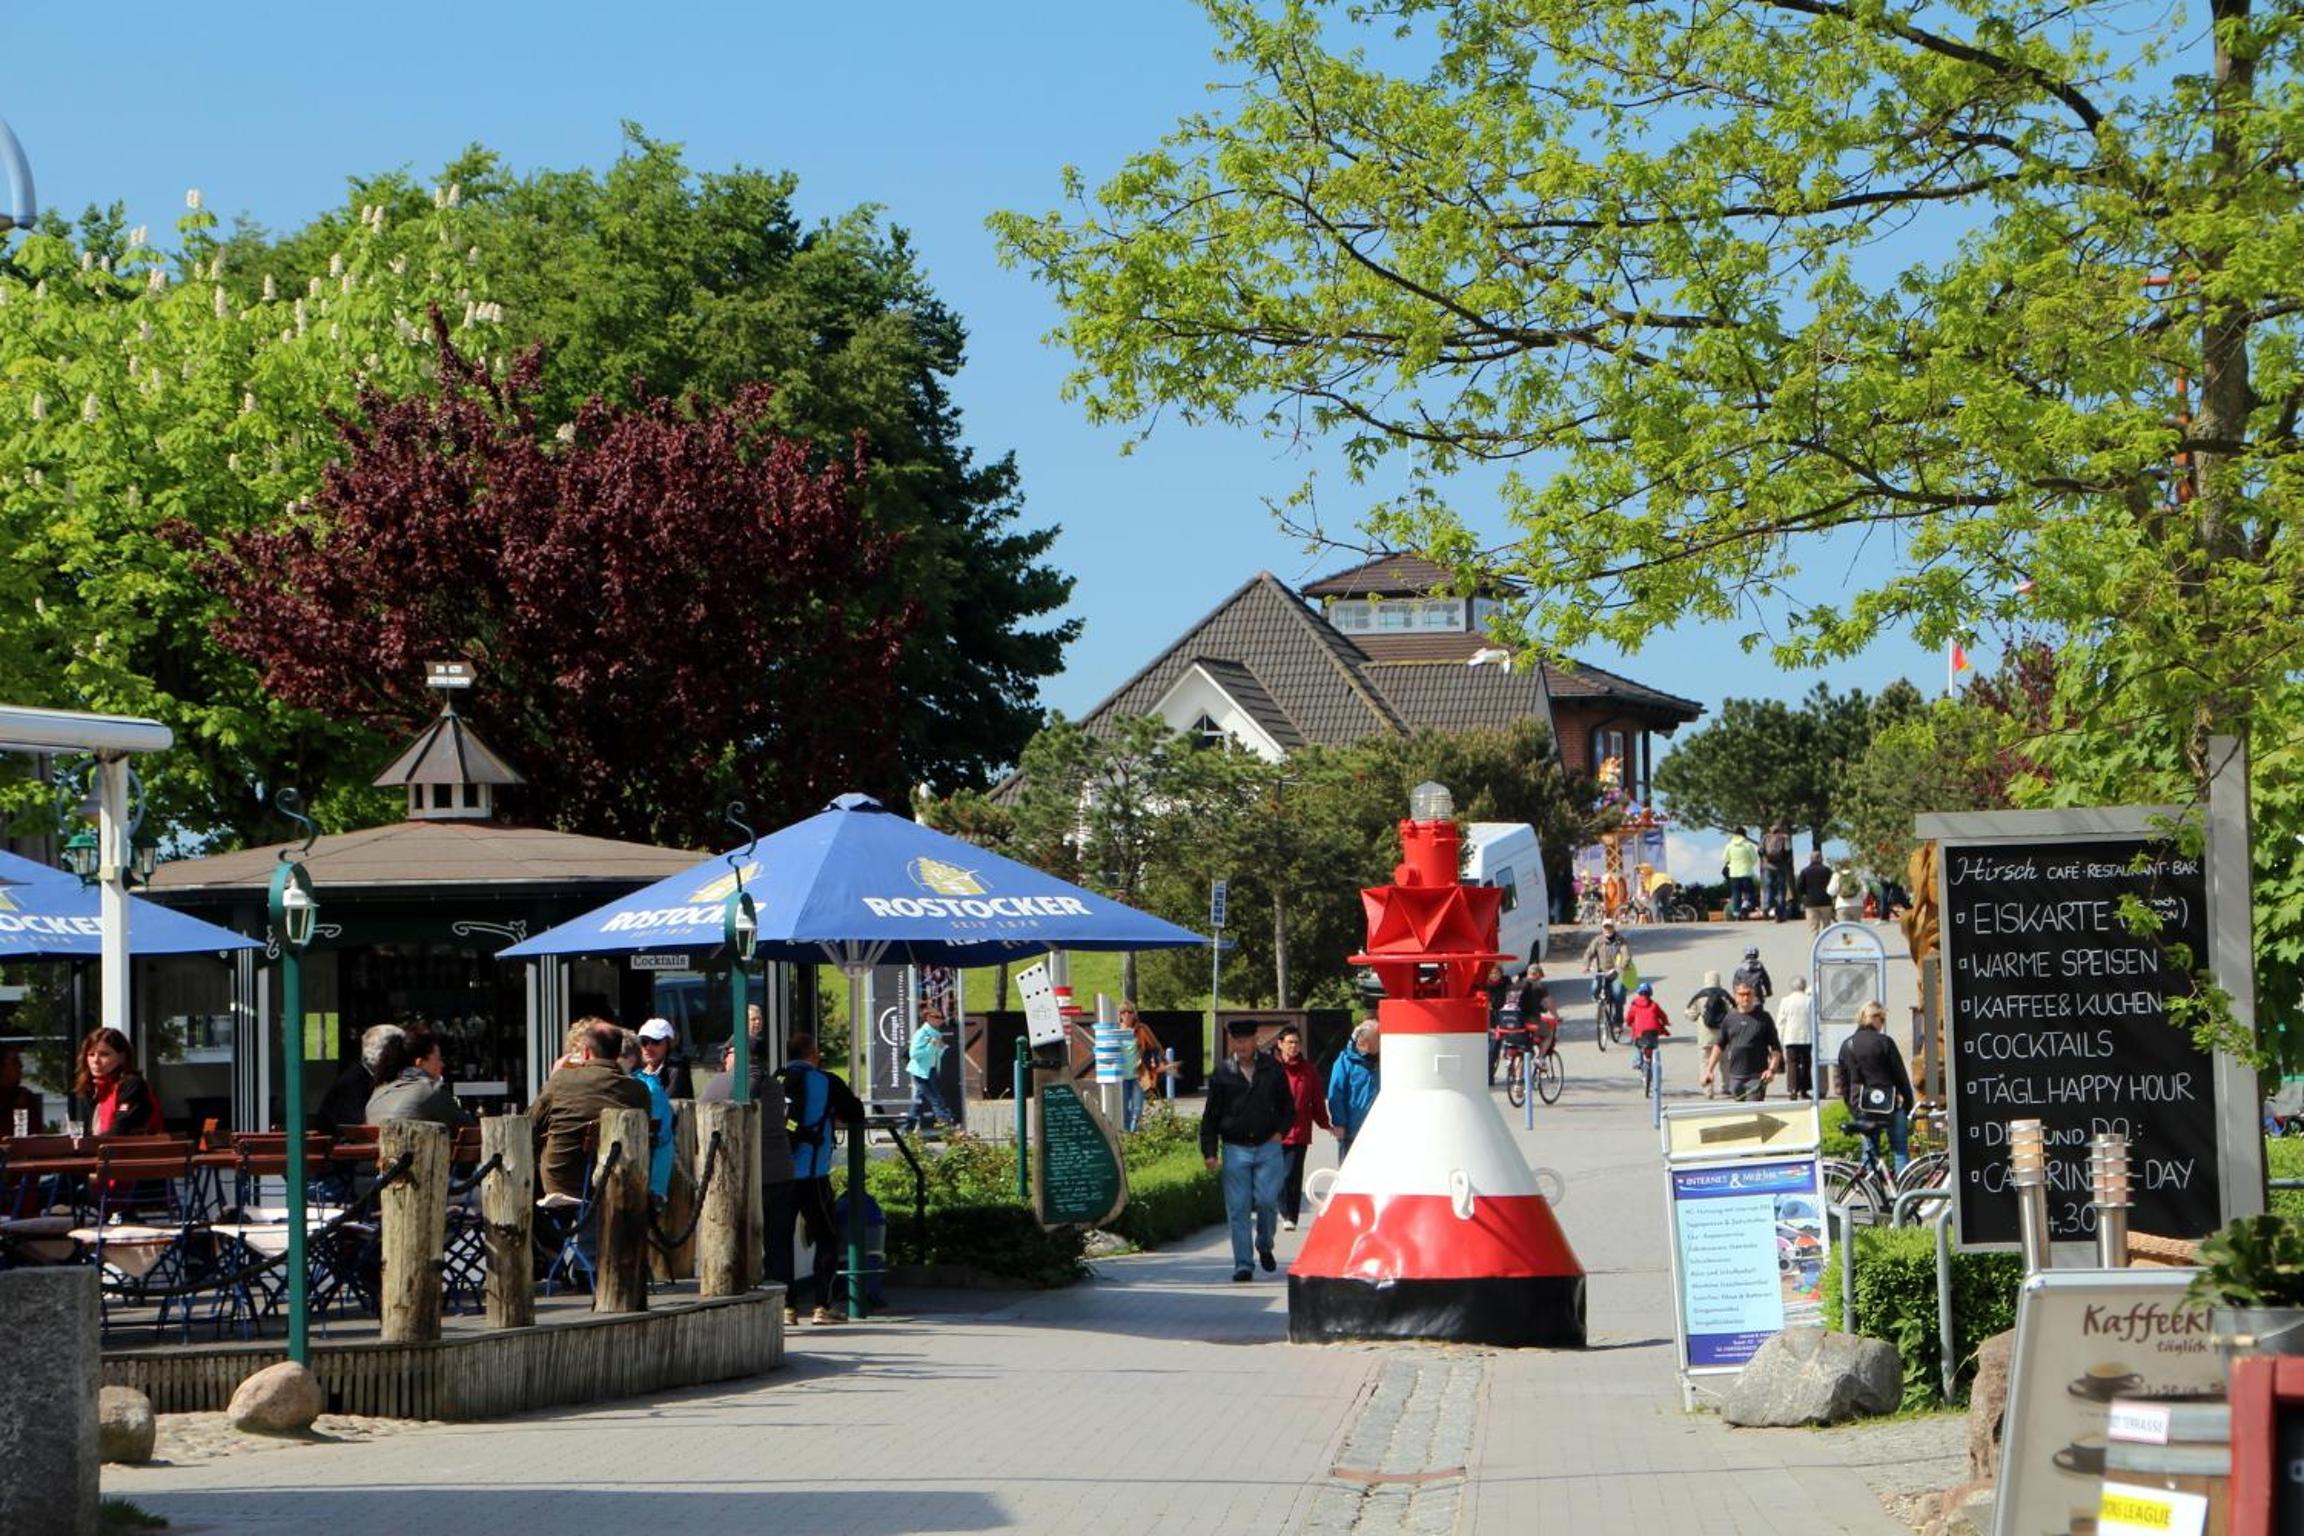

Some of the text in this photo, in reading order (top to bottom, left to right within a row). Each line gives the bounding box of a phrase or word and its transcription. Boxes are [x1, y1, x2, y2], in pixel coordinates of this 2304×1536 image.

[1951, 857, 2038, 885] Hirsch
[2172, 860, 2199, 876] BAR
[862, 896, 1093, 918] ROSTOCKER
[1974, 902, 2110, 934] EISKARTE
[1973, 948, 2158, 978] WARME SPEISEN
[2076, 991, 2163, 1016] KUCHEN
[1977, 1030, 2114, 1059] COCKTAILS
[2048, 1074, 2123, 1103] HAPPY
[2129, 1072, 2195, 1101] HOUR
